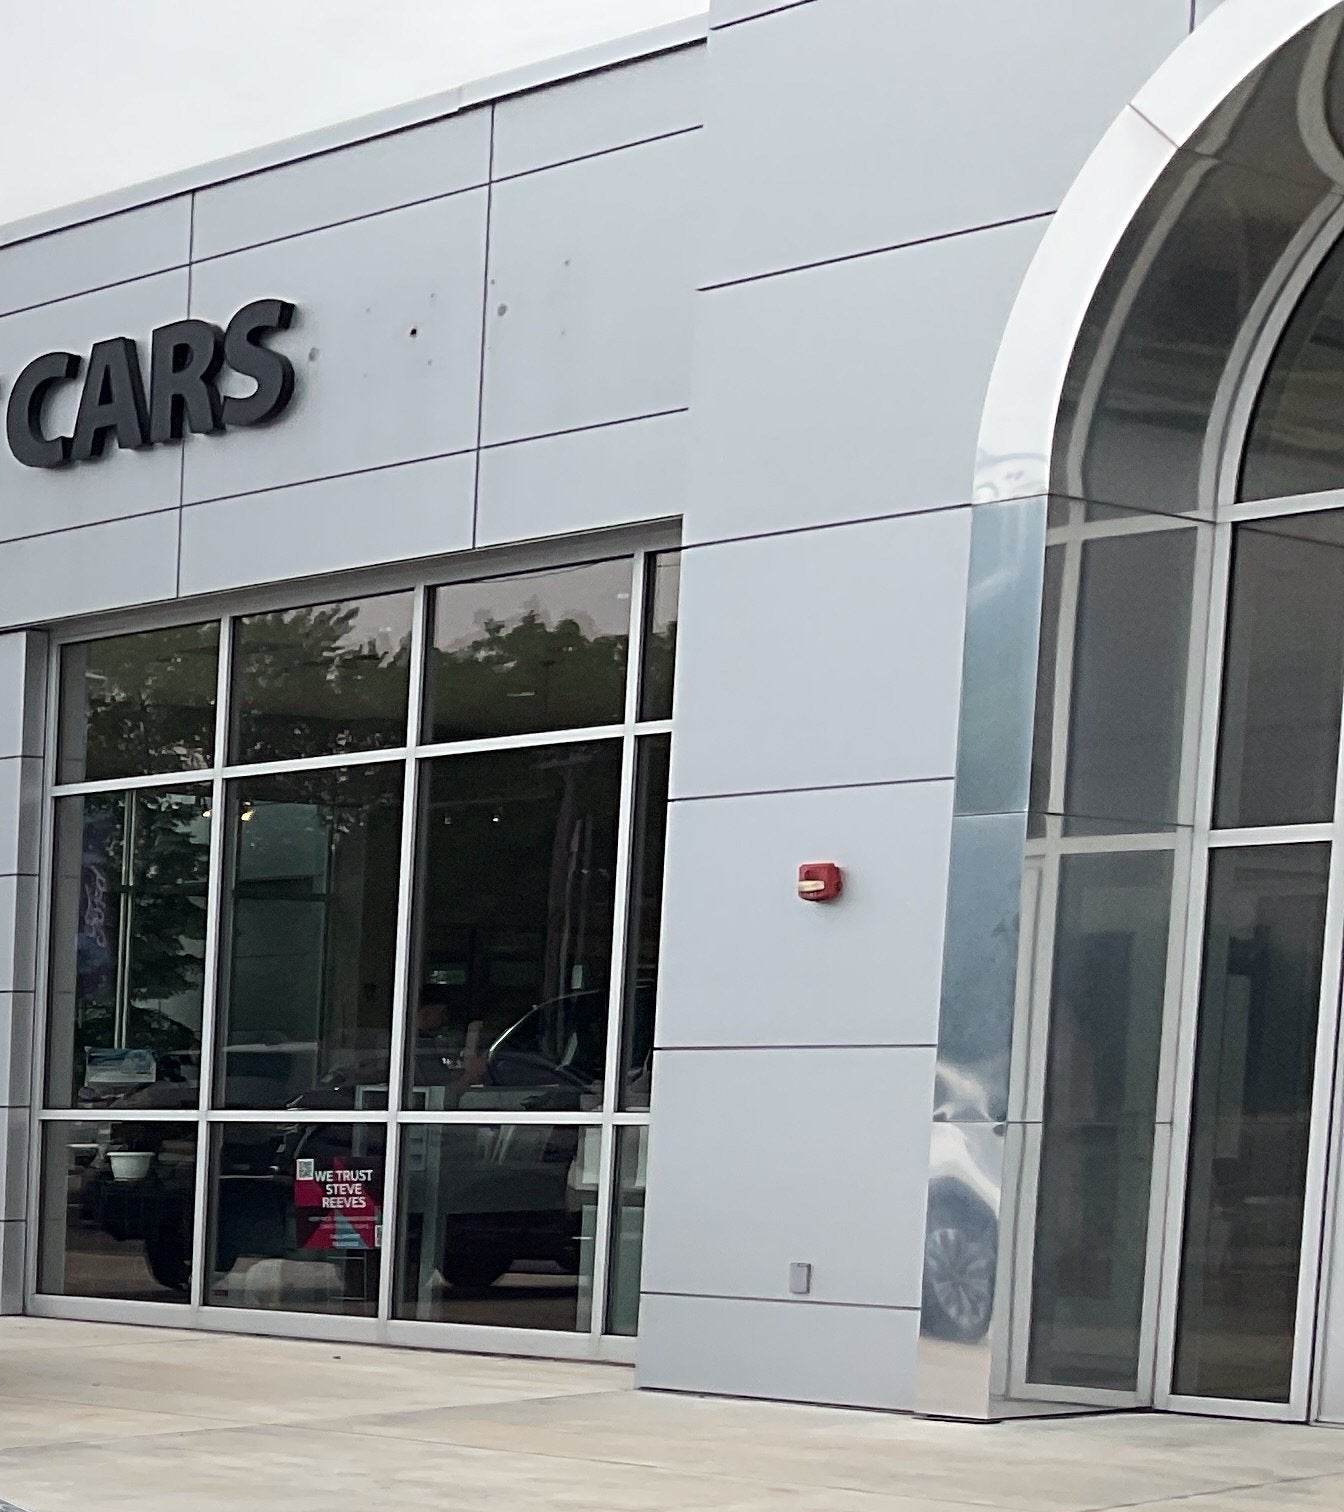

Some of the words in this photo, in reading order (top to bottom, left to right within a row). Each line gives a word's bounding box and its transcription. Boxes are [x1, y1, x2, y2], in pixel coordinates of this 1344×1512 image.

[7, 299, 296, 468] CARS
[315, 1170, 333, 1182] WE
[335, 1169, 373, 1182] TRUST
[326, 1183, 362, 1195] STEVE
[322, 1197, 366, 1209] REEVES
